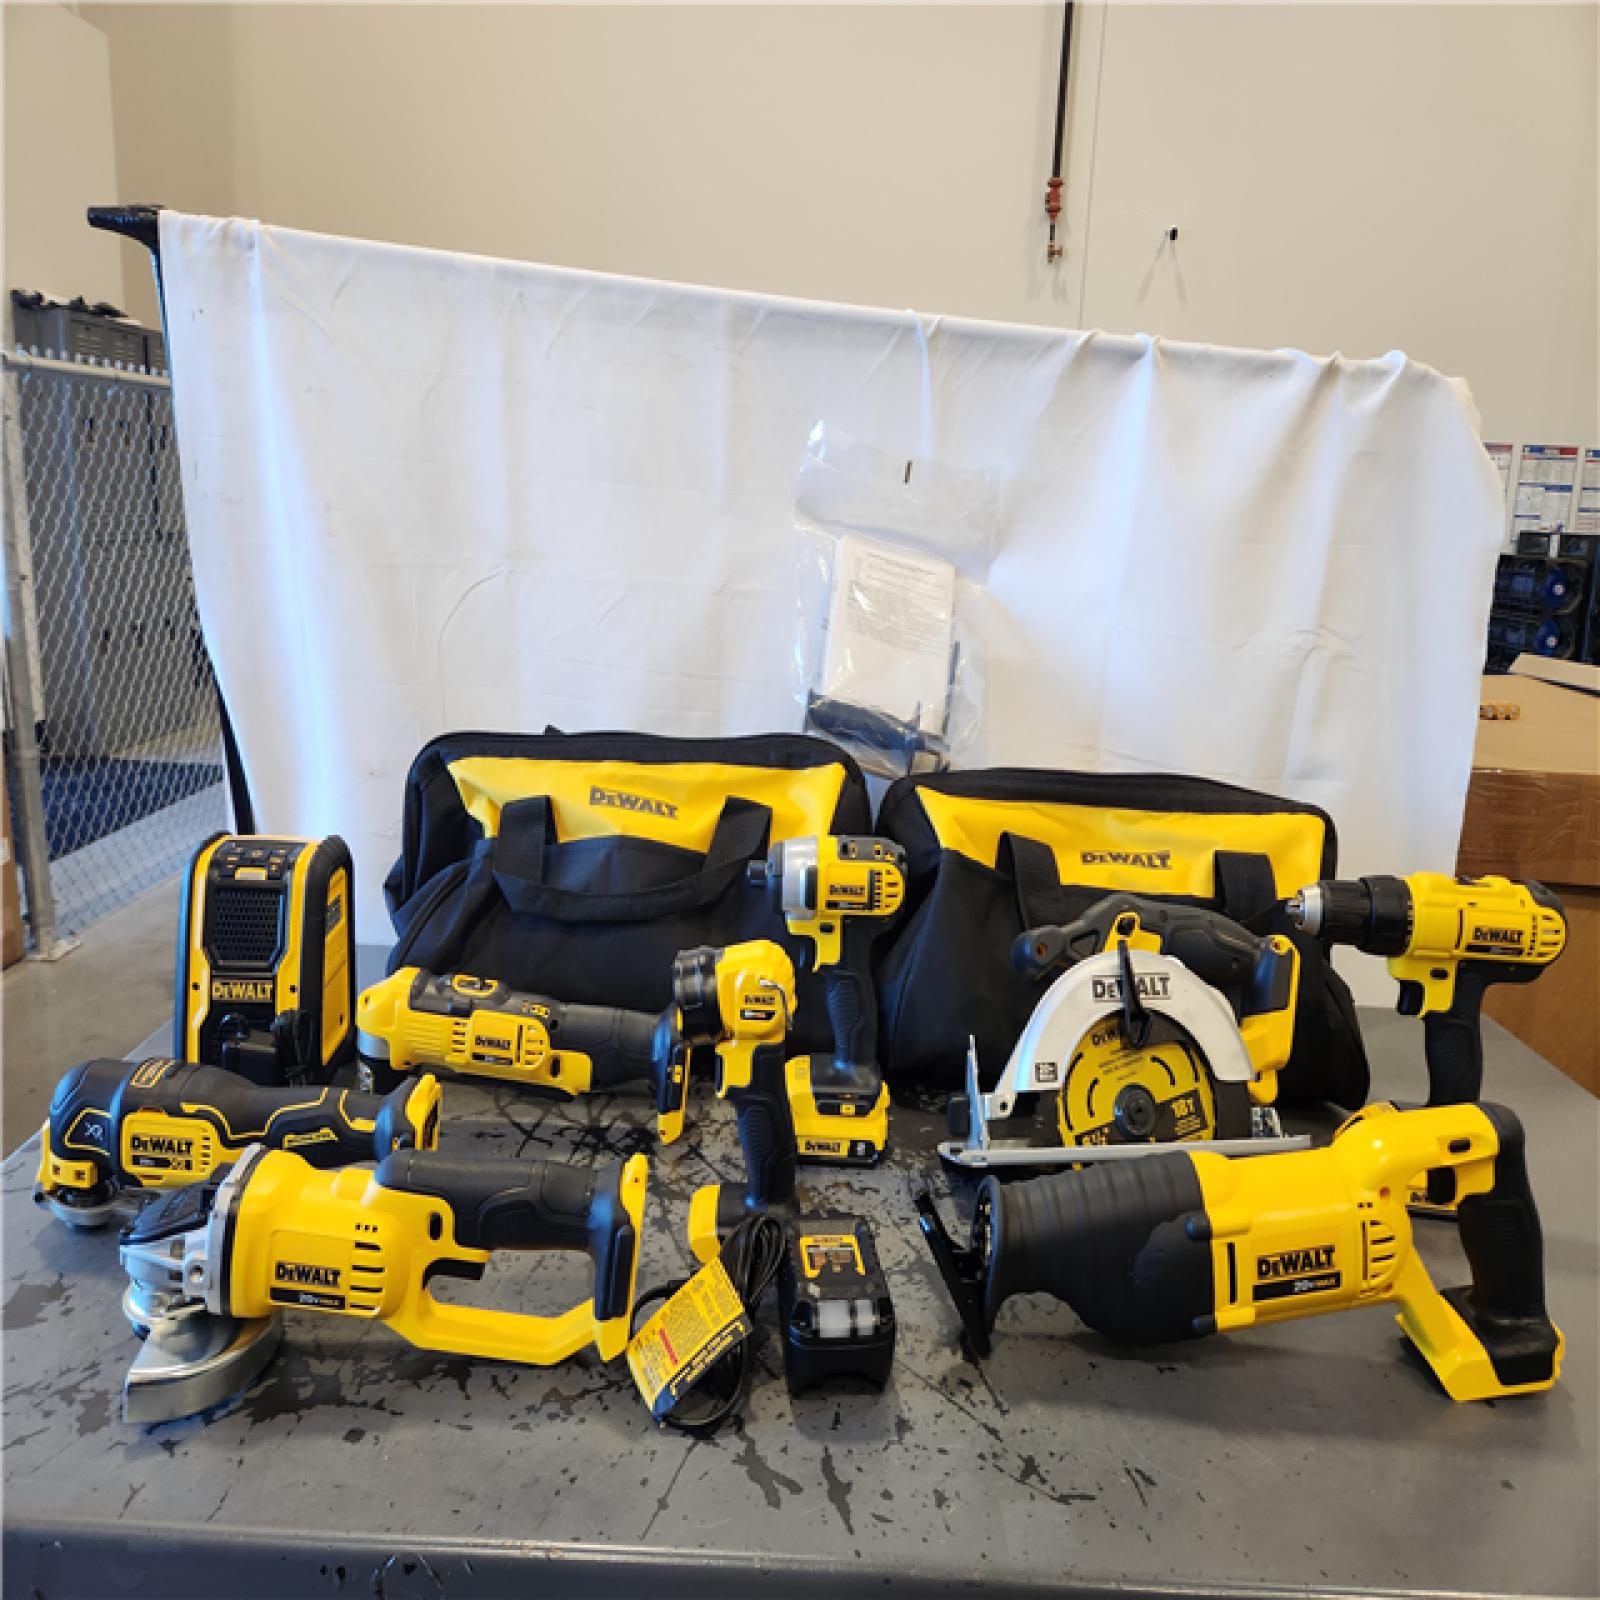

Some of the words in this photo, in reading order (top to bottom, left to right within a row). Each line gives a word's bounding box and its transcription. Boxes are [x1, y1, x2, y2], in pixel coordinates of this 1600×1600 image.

[590, 785, 678, 819] DEWALT
[1081, 850, 1171, 869] DEWALT
[1474, 926, 1523, 943] DEWALT
[212, 979, 273, 1001] DEWALT
[1093, 975, 1171, 1000] DEALT
[130, 1134, 193, 1155] DEWALT
[274, 1259, 341, 1288] DEWALT
[1256, 1246, 1336, 1280] DEWALT
